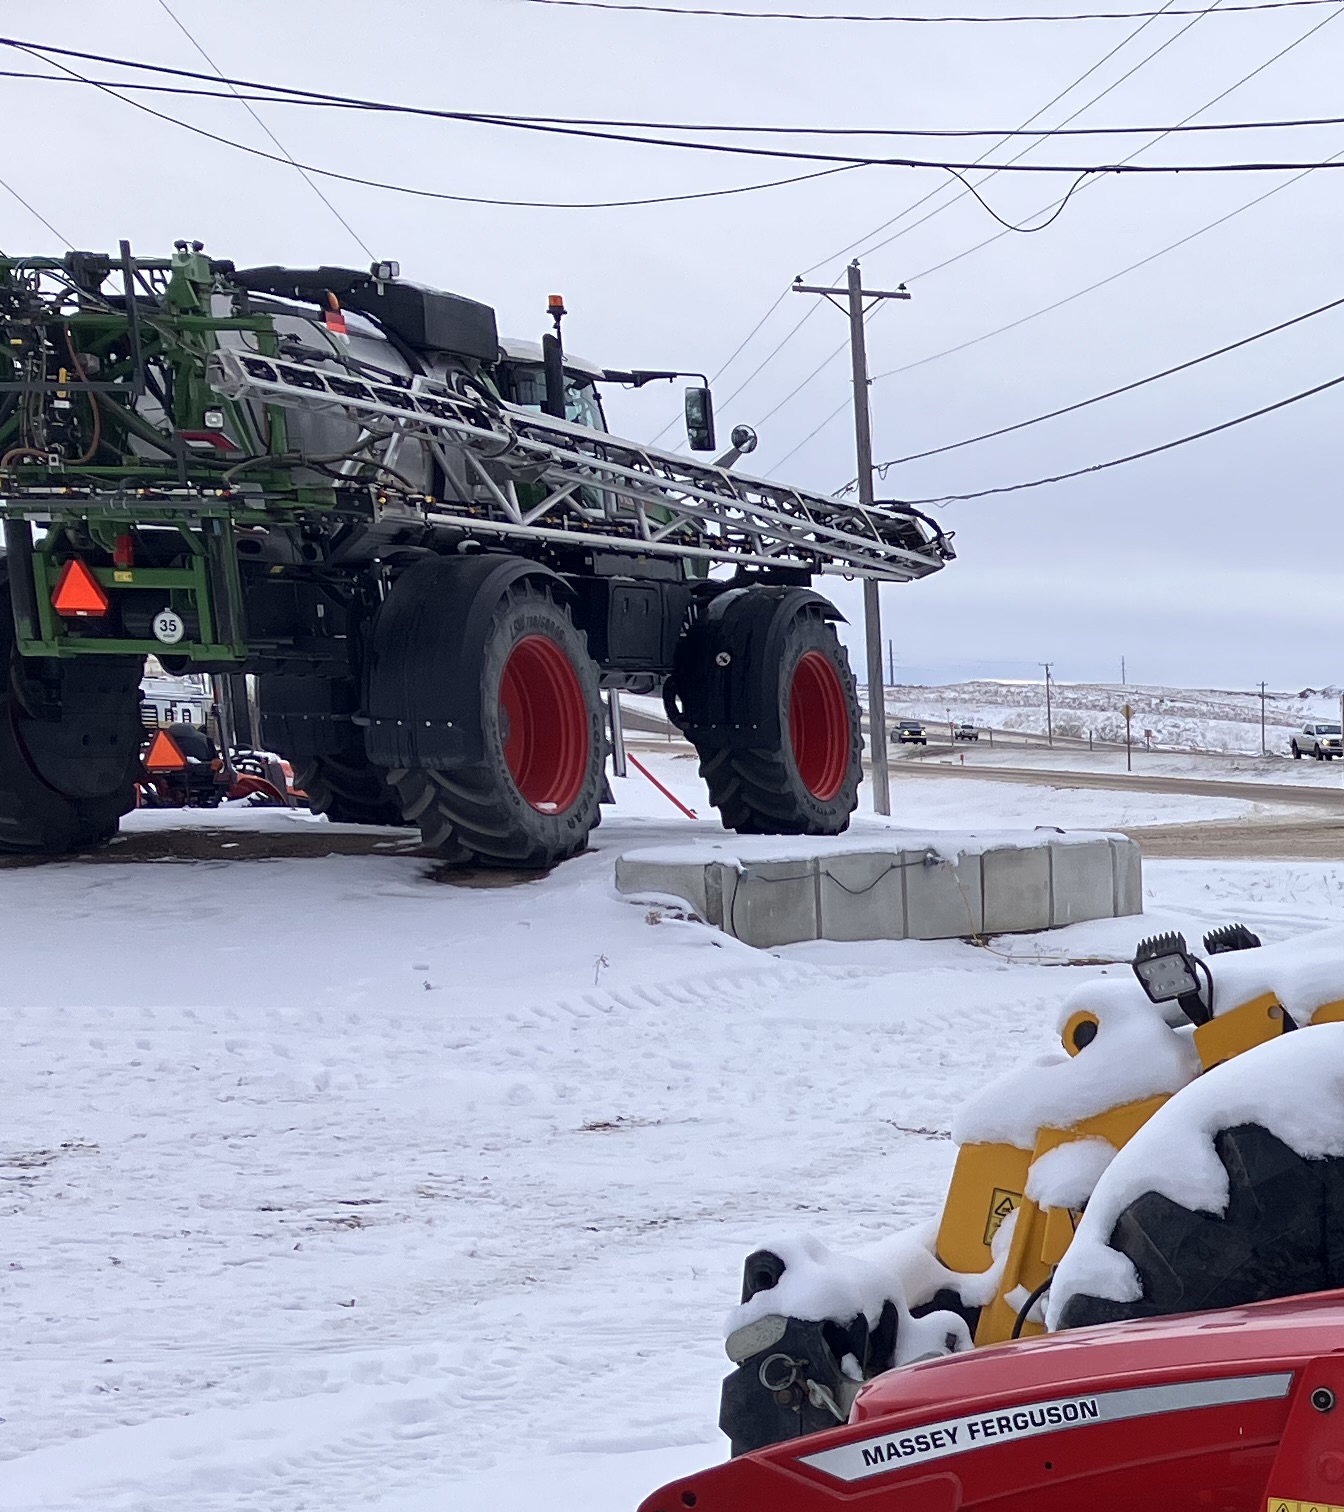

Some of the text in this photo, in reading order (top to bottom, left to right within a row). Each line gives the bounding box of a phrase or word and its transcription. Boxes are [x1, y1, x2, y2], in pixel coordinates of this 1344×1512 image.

[159, 619, 177, 632] 35
[861, 1398, 1100, 1467] MASSEY FERGUSON
